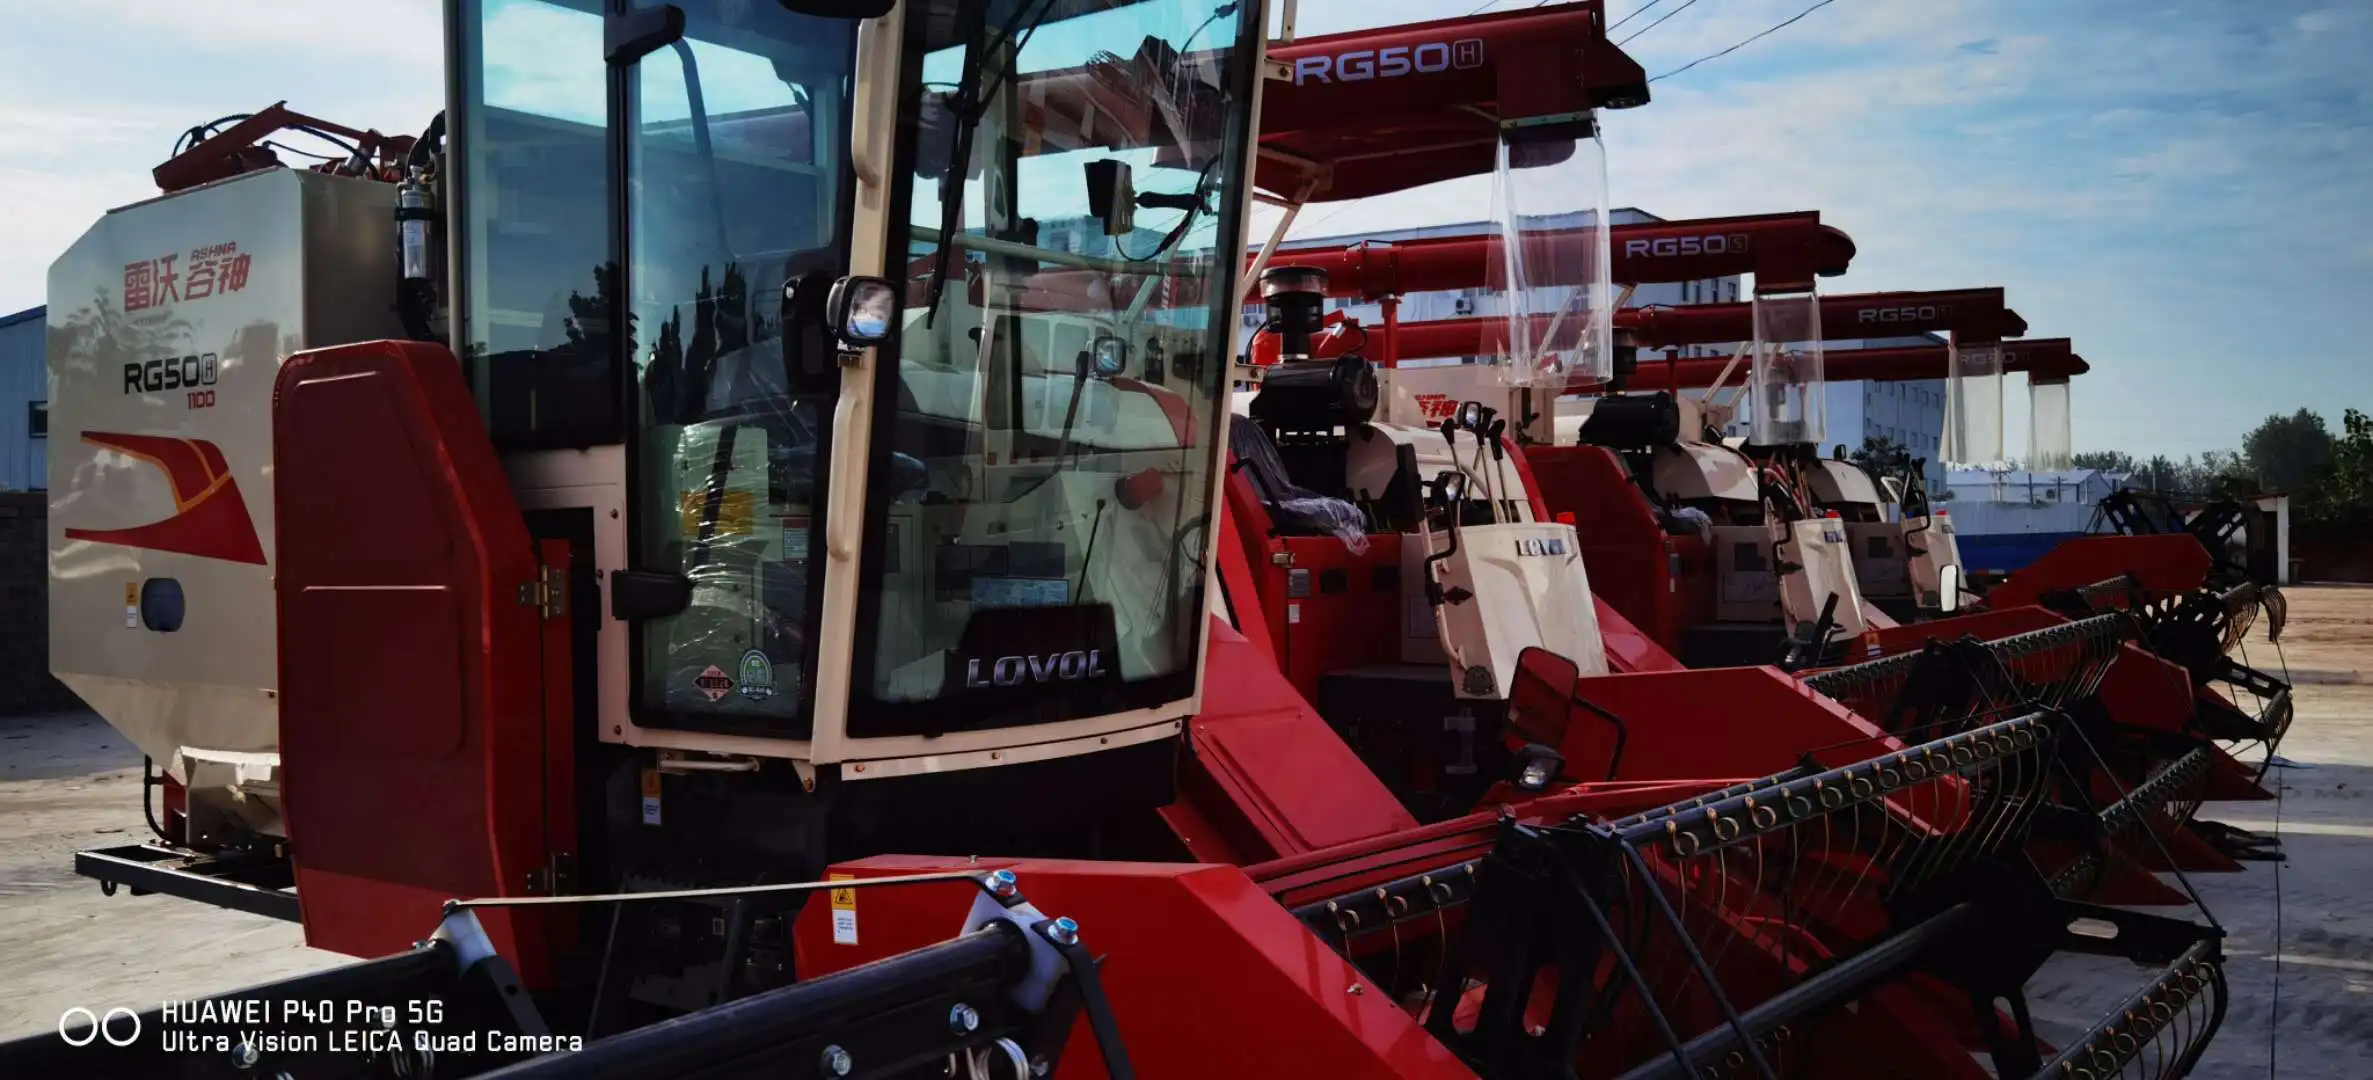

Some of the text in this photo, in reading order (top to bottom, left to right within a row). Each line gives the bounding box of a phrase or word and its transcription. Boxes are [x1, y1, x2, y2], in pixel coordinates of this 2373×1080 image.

[124, 253, 252, 312] 雷沃 谷神
[187, 390, 216, 410] 1100
[966, 650, 1107, 688] LOVOL
